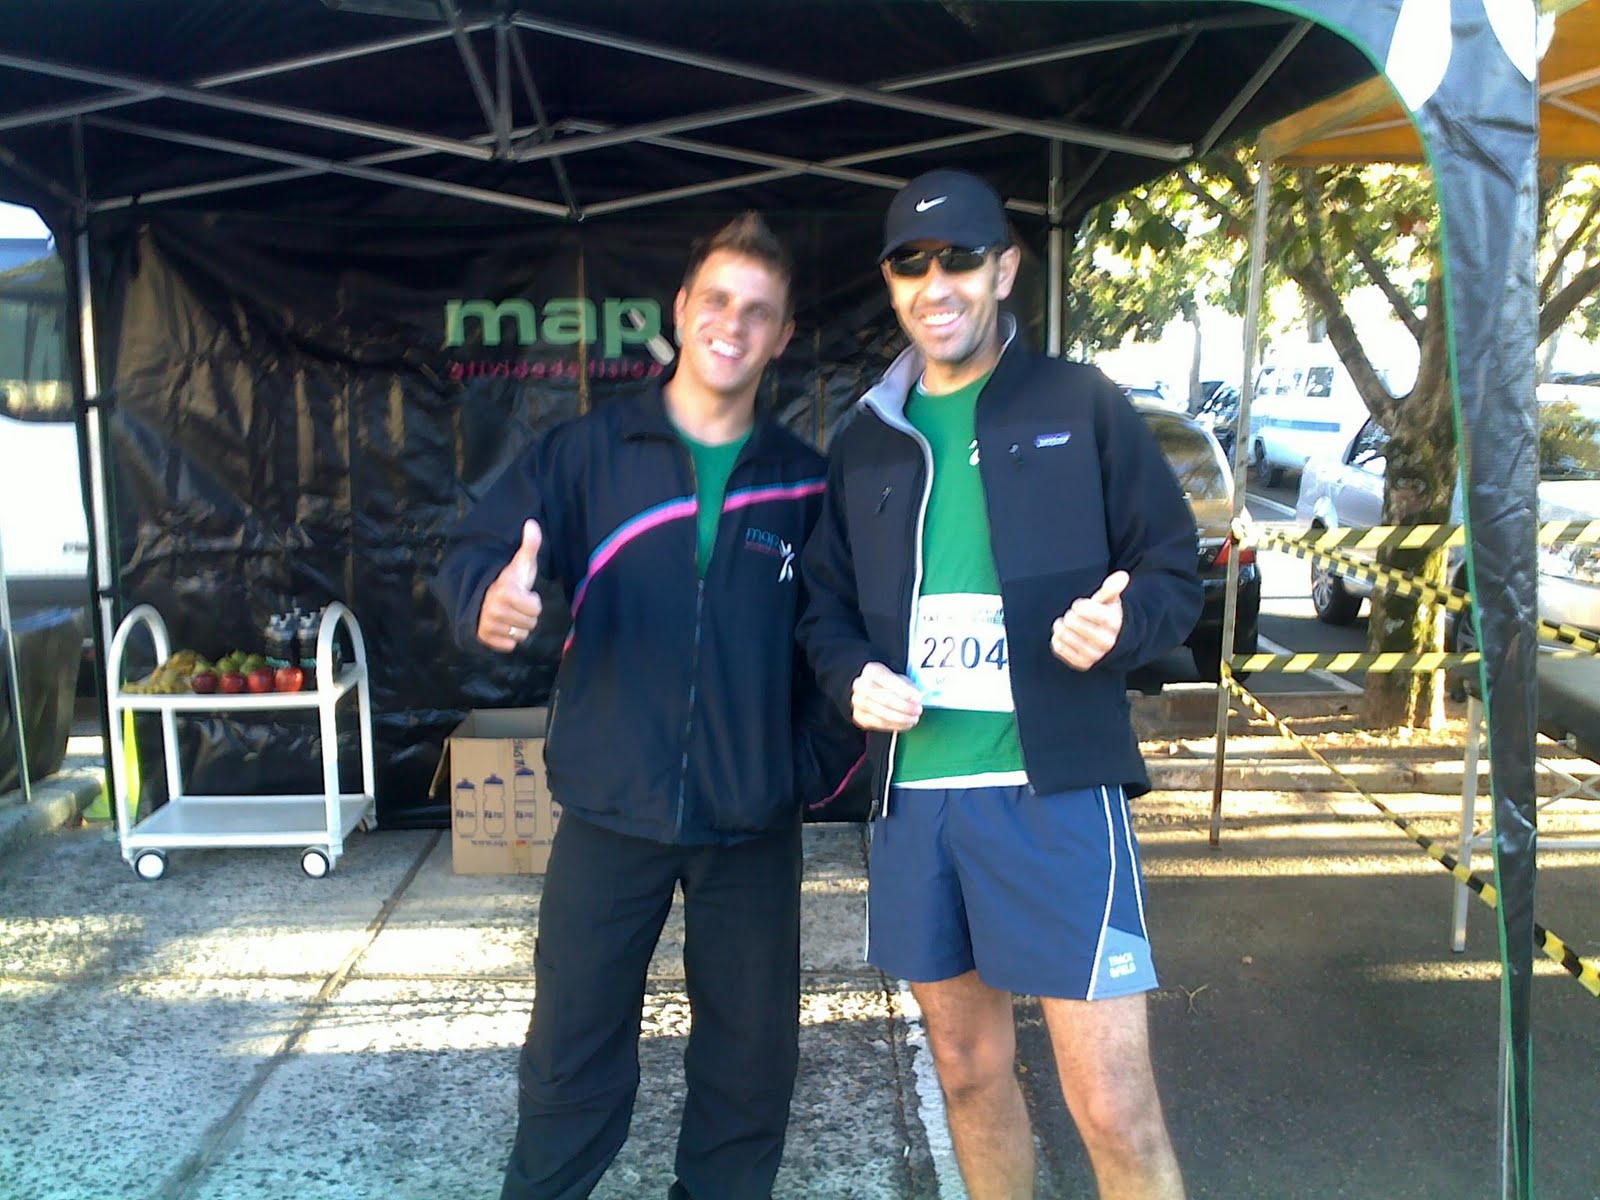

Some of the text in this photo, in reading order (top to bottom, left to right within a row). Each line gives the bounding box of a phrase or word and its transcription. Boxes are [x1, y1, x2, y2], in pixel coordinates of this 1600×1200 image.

[445, 297, 662, 358] map
[745, 527, 780, 551] map
[920, 636, 1008, 670] 2204
